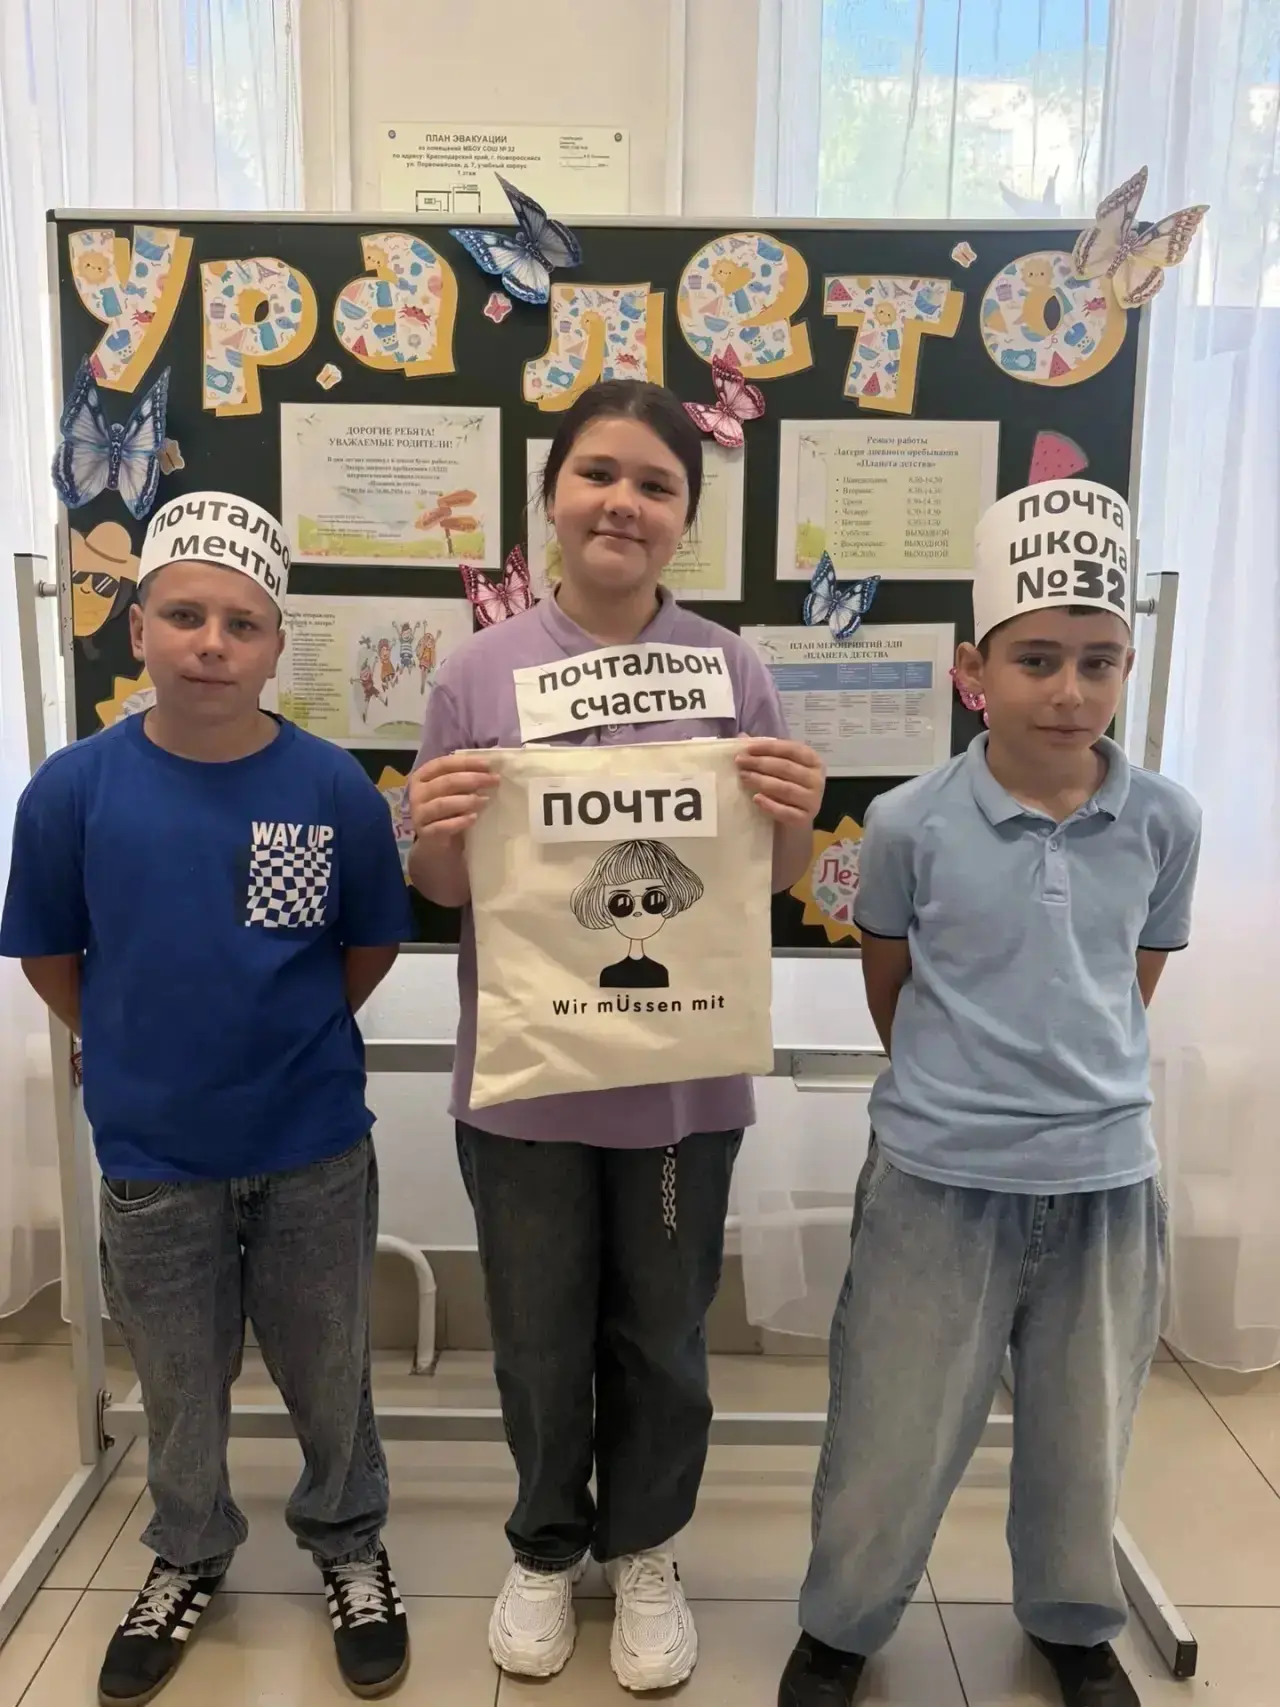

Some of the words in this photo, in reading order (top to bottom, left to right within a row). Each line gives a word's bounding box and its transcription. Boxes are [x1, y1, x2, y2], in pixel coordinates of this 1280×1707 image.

[426, 134, 450, 143] ПЛАН
[452, 135, 507, 144] ЭВАКУАЦИИ
[328, 438, 394, 448] УВАЖАЕМЫЕ
[396, 438, 453, 449] РОДИТЕЛИ!
[346, 426, 392, 436] ДОРОГИЕ
[394, 427, 435, 437] РЕБЯТА!
[897, 436, 928, 446] работы
[1018, 489, 1124, 531] почта
[170, 534, 281, 597] мечты
[1009, 530, 1128, 574] школа
[790, 641, 815, 650] ПЛАН
[816, 640, 883, 650] МЕРОПРИЯТИЙ
[538, 651, 724, 694] почтальон
[570, 688, 707, 720] счастья
[542, 786, 703, 827] почта
[251, 821, 303, 847] WAY
[306, 824, 334, 848] UP
[552, 998, 588, 1016] Wir
[597, 994, 682, 1013] mÜssen
[692, 994, 725, 1011] mit
